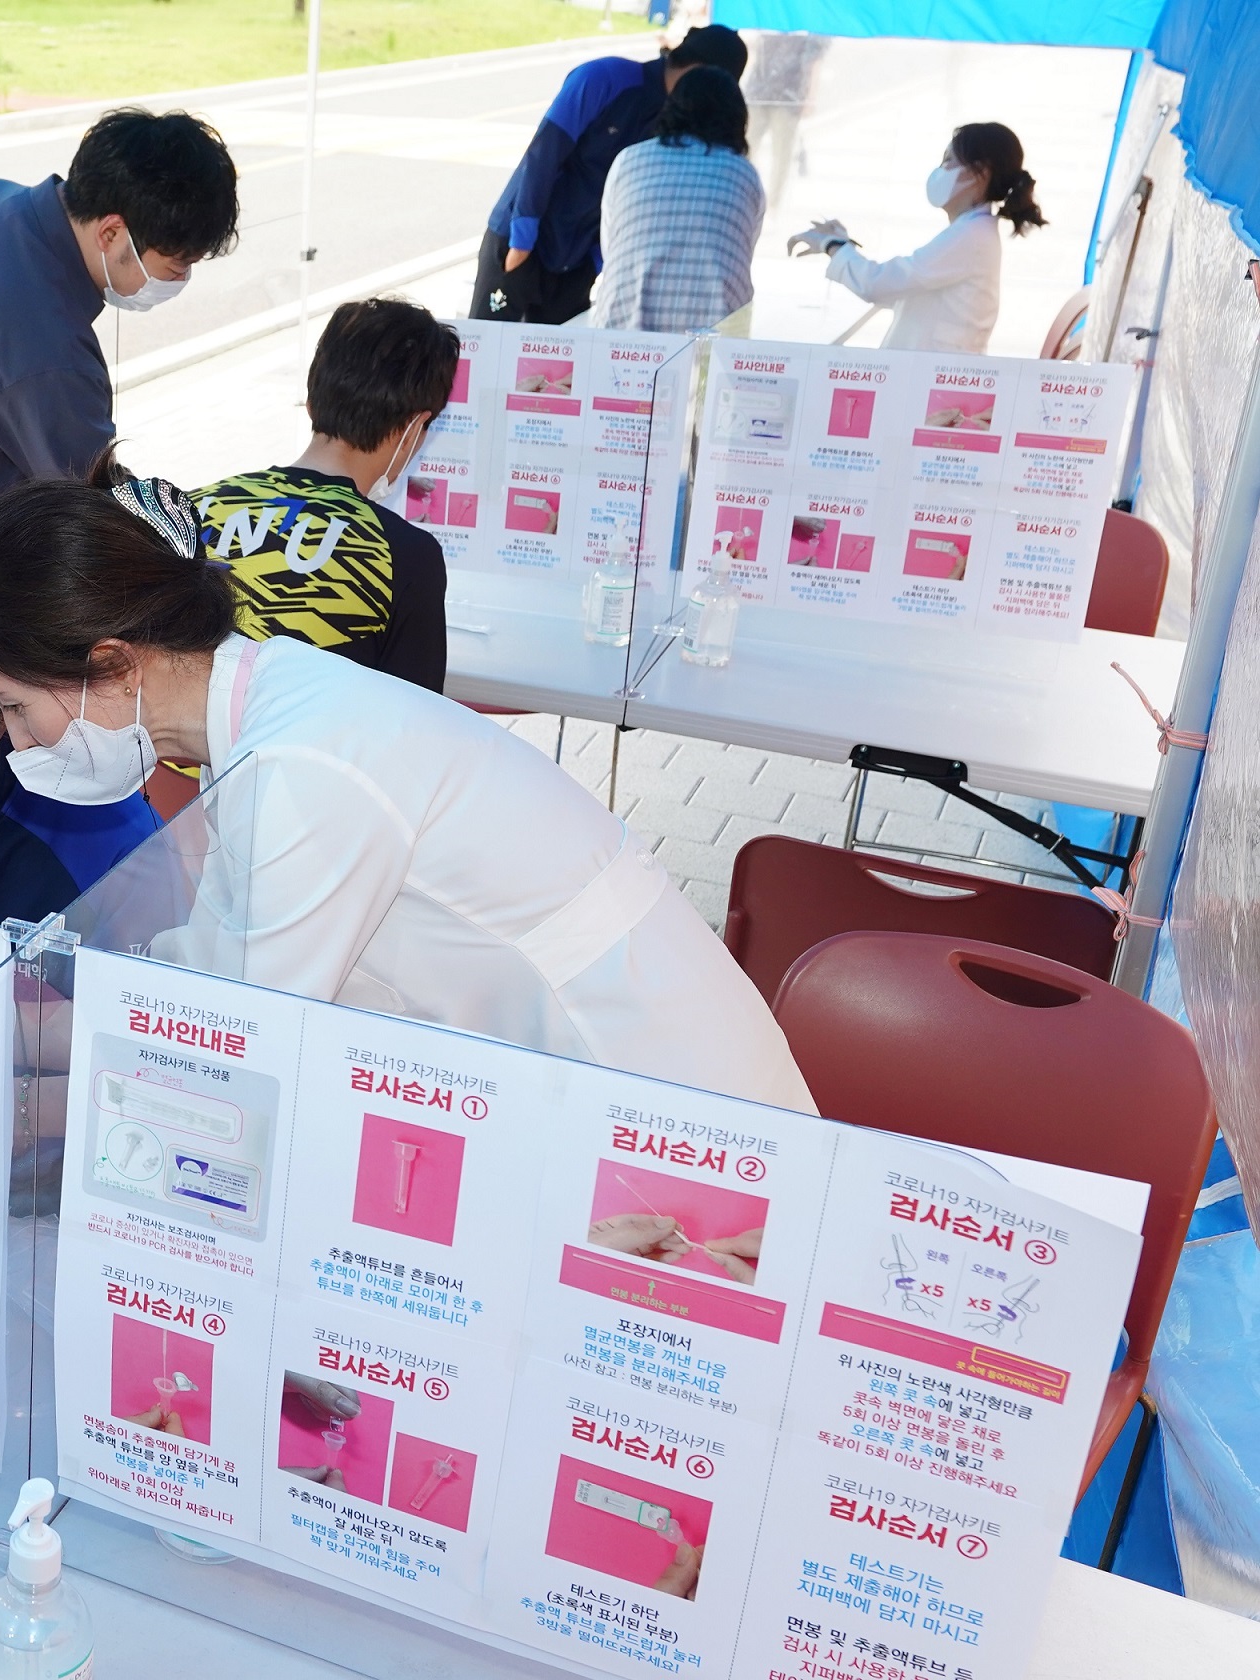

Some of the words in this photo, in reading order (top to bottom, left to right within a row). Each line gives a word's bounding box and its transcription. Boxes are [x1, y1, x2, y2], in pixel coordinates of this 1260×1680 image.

[119, 991, 175, 1015] 코로나19
[179, 1005, 258, 1035] 자가검사키트
[129, 1009, 245, 1058] 검사안내문
[139, 1049, 196, 1072] 자가검사키트
[201, 1065, 229, 1082] 구성품
[344, 1047, 405, 1072] 코로나19
[410, 1062, 497, 1095] 자가검사키트
[351, 1067, 452, 1112] 검사순서
[606, 1104, 675, 1131] 코로나19
[679, 1121, 777, 1156] 자가검사키트
[612, 1125, 726, 1173] 검사순서
[127, 1213, 165, 1231] 자가검사는
[168, 1225, 215, 1245] 보조검사이며
[884, 1171, 959, 1204] 코로나19
[964, 1196, 1068, 1245] 자가검사키트
[890, 1193, 1014, 1251] 검사순서
[101, 1264, 154, 1290] 코로나19
[158, 1281, 233, 1314] 자가검사키트
[310, 1258, 360, 1282] 추출액이
[365, 1273, 403, 1293] 아래로
[408, 1284, 447, 1305] 모이게
[453, 1295, 465, 1310] 한
[470, 1300, 482, 1313] 후
[329, 1247, 405, 1278] 추출액튜브를
[411, 1268, 462, 1292] 흔들어서
[107, 1282, 194, 1327] 검사순서
[317, 1276, 354, 1296] 튜브를
[360, 1287, 397, 1309] 한쪽에
[402, 1299, 468, 1327] 세워둡니다
[313, 1327, 371, 1353] 코로나19
[375, 1345, 458, 1378] 자가검사키트
[584, 1325, 656, 1358] 멸균면봉을
[662, 1349, 691, 1369] 꺼낸
[697, 1359, 726, 1378] 다음
[617, 1319, 691, 1350] 포장지에서
[319, 1346, 415, 1392] 검사순서
[584, 1342, 626, 1367] 면봉을
[632, 1358, 720, 1394] 분리해주세요
[838, 1354, 852, 1368] 위
[857, 1359, 901, 1381] 사진의
[906, 1372, 951, 1396] 노란색
[956, 1387, 1032, 1420] 사각형만큼
[566, 1396, 629, 1426] 코로나19
[634, 1418, 725, 1456] 자가검사키트
[572, 1416, 677, 1468] 검사순서
[853, 1391, 882, 1409] 콧속
[888, 1400, 931, 1423] 벽면에
[937, 1414, 965, 1433] 닿은
[971, 1425, 1000, 1443] 채로
[88, 1467, 131, 1492] 위아래로
[136, 1486, 180, 1509] 휘저으며
[186, 1501, 233, 1524] 짜줍니다
[131, 1472, 155, 1488] 10회
[160, 1481, 183, 1496] 이상
[824, 1474, 895, 1504] 코로나19
[900, 1496, 1000, 1537] 자가검사키트
[334, 1517, 346, 1530] 잘
[350, 1523, 375, 1540] 세운
[380, 1533, 391, 1546] 뒤
[829, 1494, 947, 1548] 검사순서
[802, 1559, 836, 1582] 별도
[844, 1573, 920, 1608] 제출해야
[927, 1597, 983, 1626] 하므로
[849, 1553, 943, 1594] 테스트기는
[570, 1583, 625, 1611] 테스트기
[631, 1603, 659, 1621] 하단
